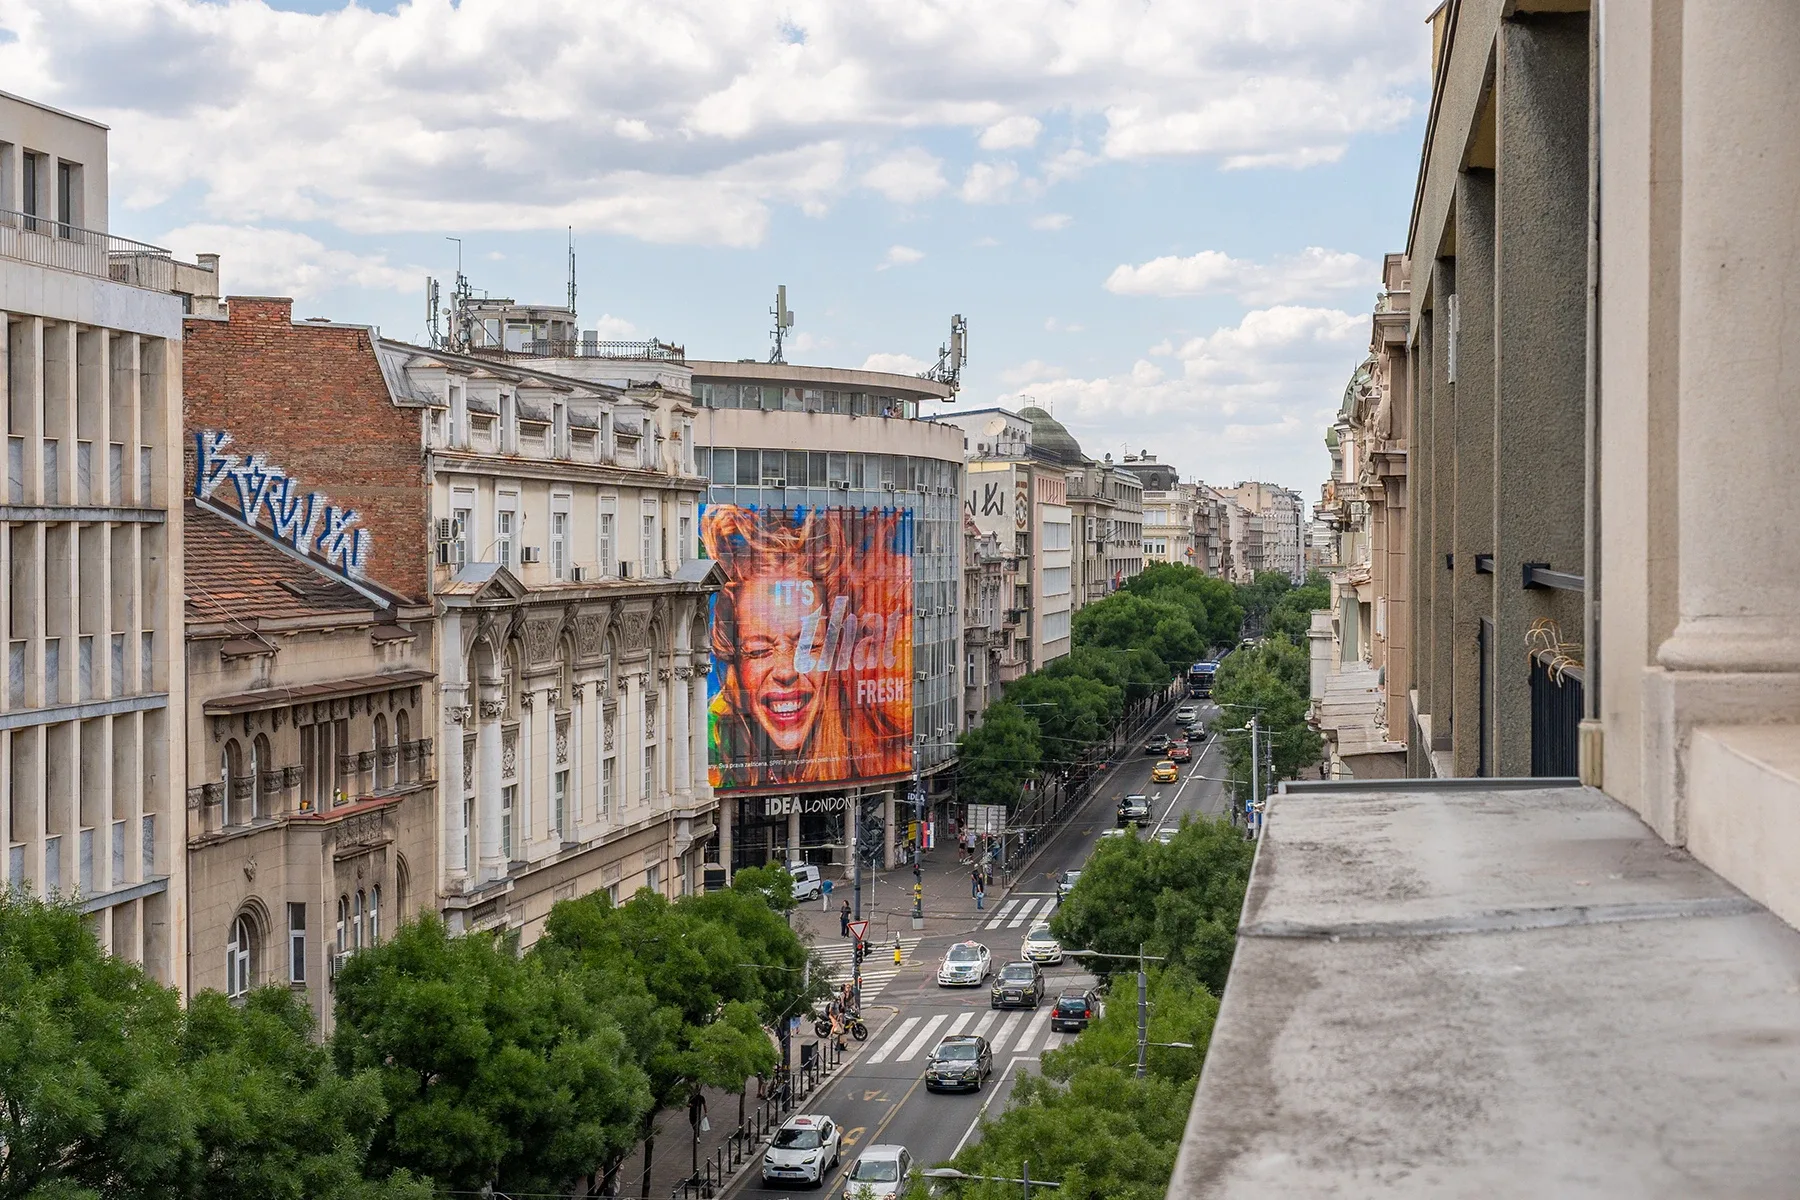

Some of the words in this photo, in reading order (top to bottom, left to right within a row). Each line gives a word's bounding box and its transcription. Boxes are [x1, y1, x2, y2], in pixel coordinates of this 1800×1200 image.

[774, 579, 815, 606] IT'S
[793, 595, 904, 674] that
[857, 677, 905, 704] FRESH
[804, 796, 852, 814] LONDON
